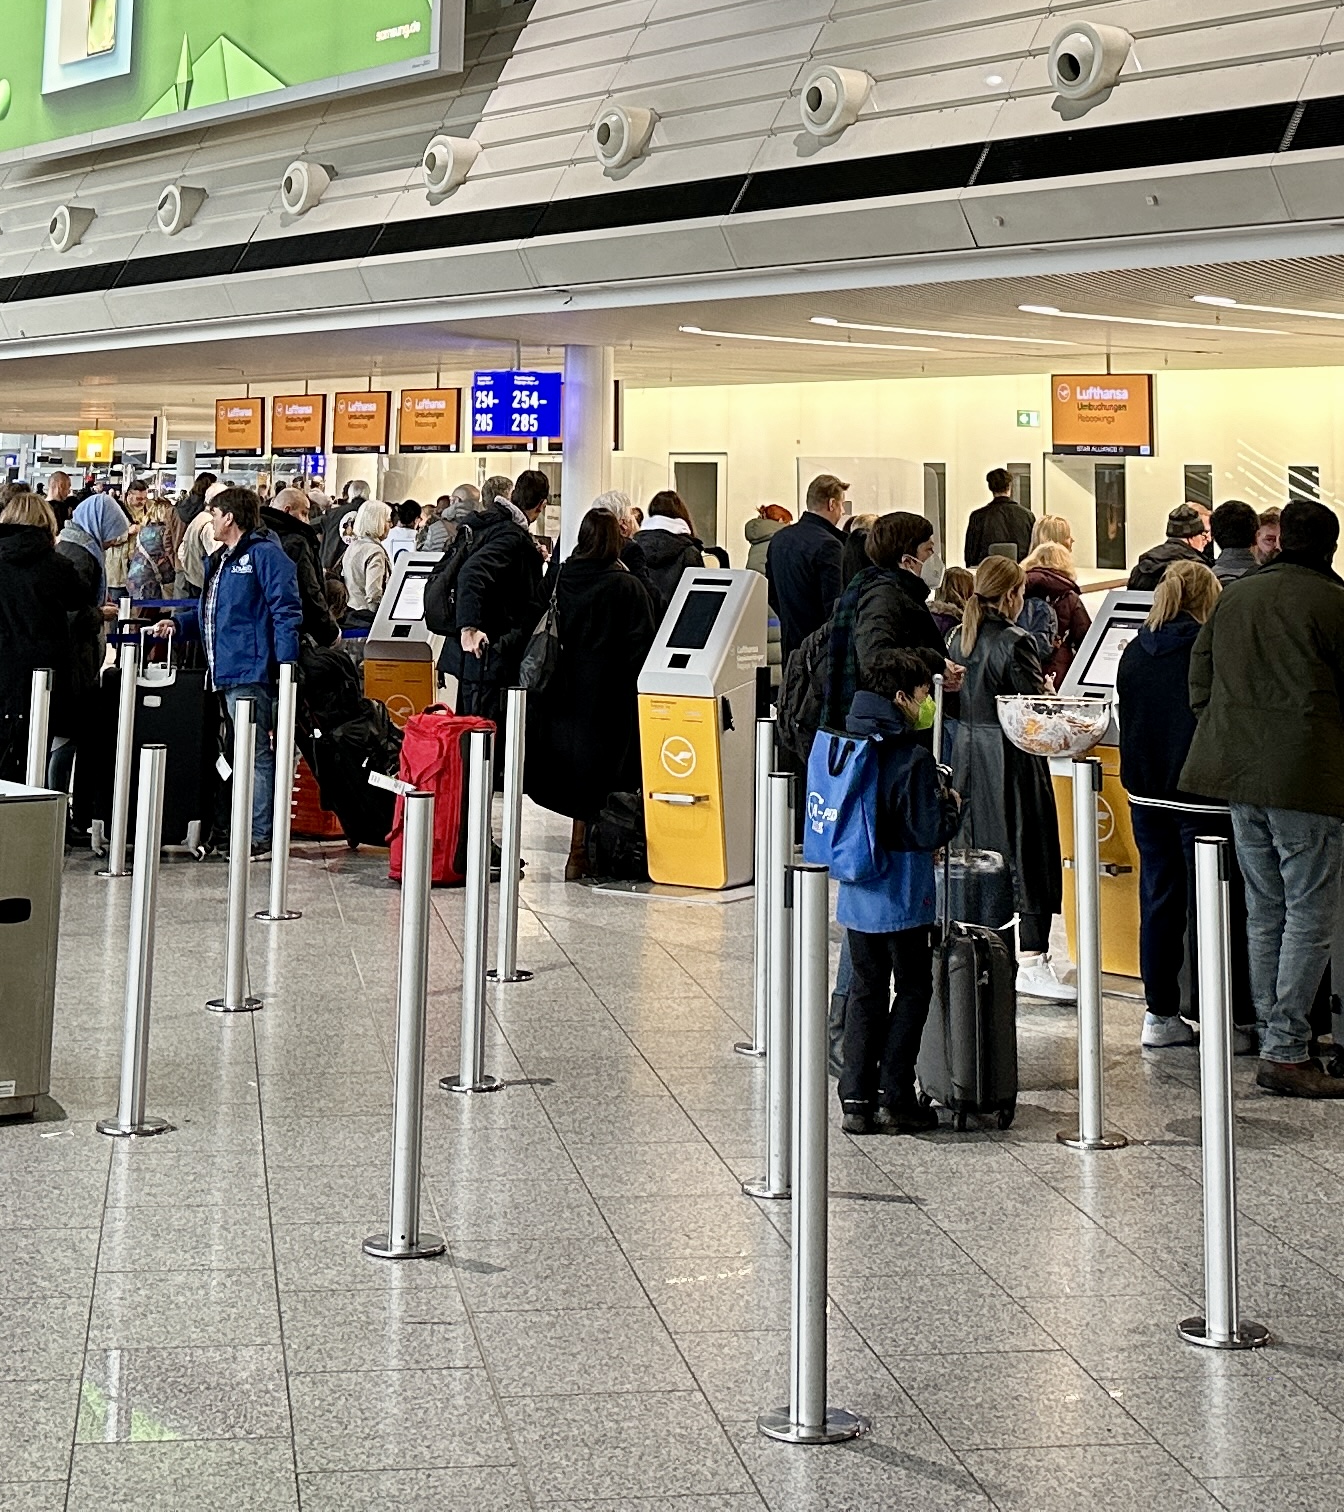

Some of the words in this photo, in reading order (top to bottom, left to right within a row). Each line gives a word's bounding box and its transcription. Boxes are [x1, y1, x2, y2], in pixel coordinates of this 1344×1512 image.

[512, 390, 548, 409] 254-
[1076, 386, 1129, 400] Lufthansa
[1077, 402, 1127, 413] Umbuchungen
[511, 414, 539, 432] 285
